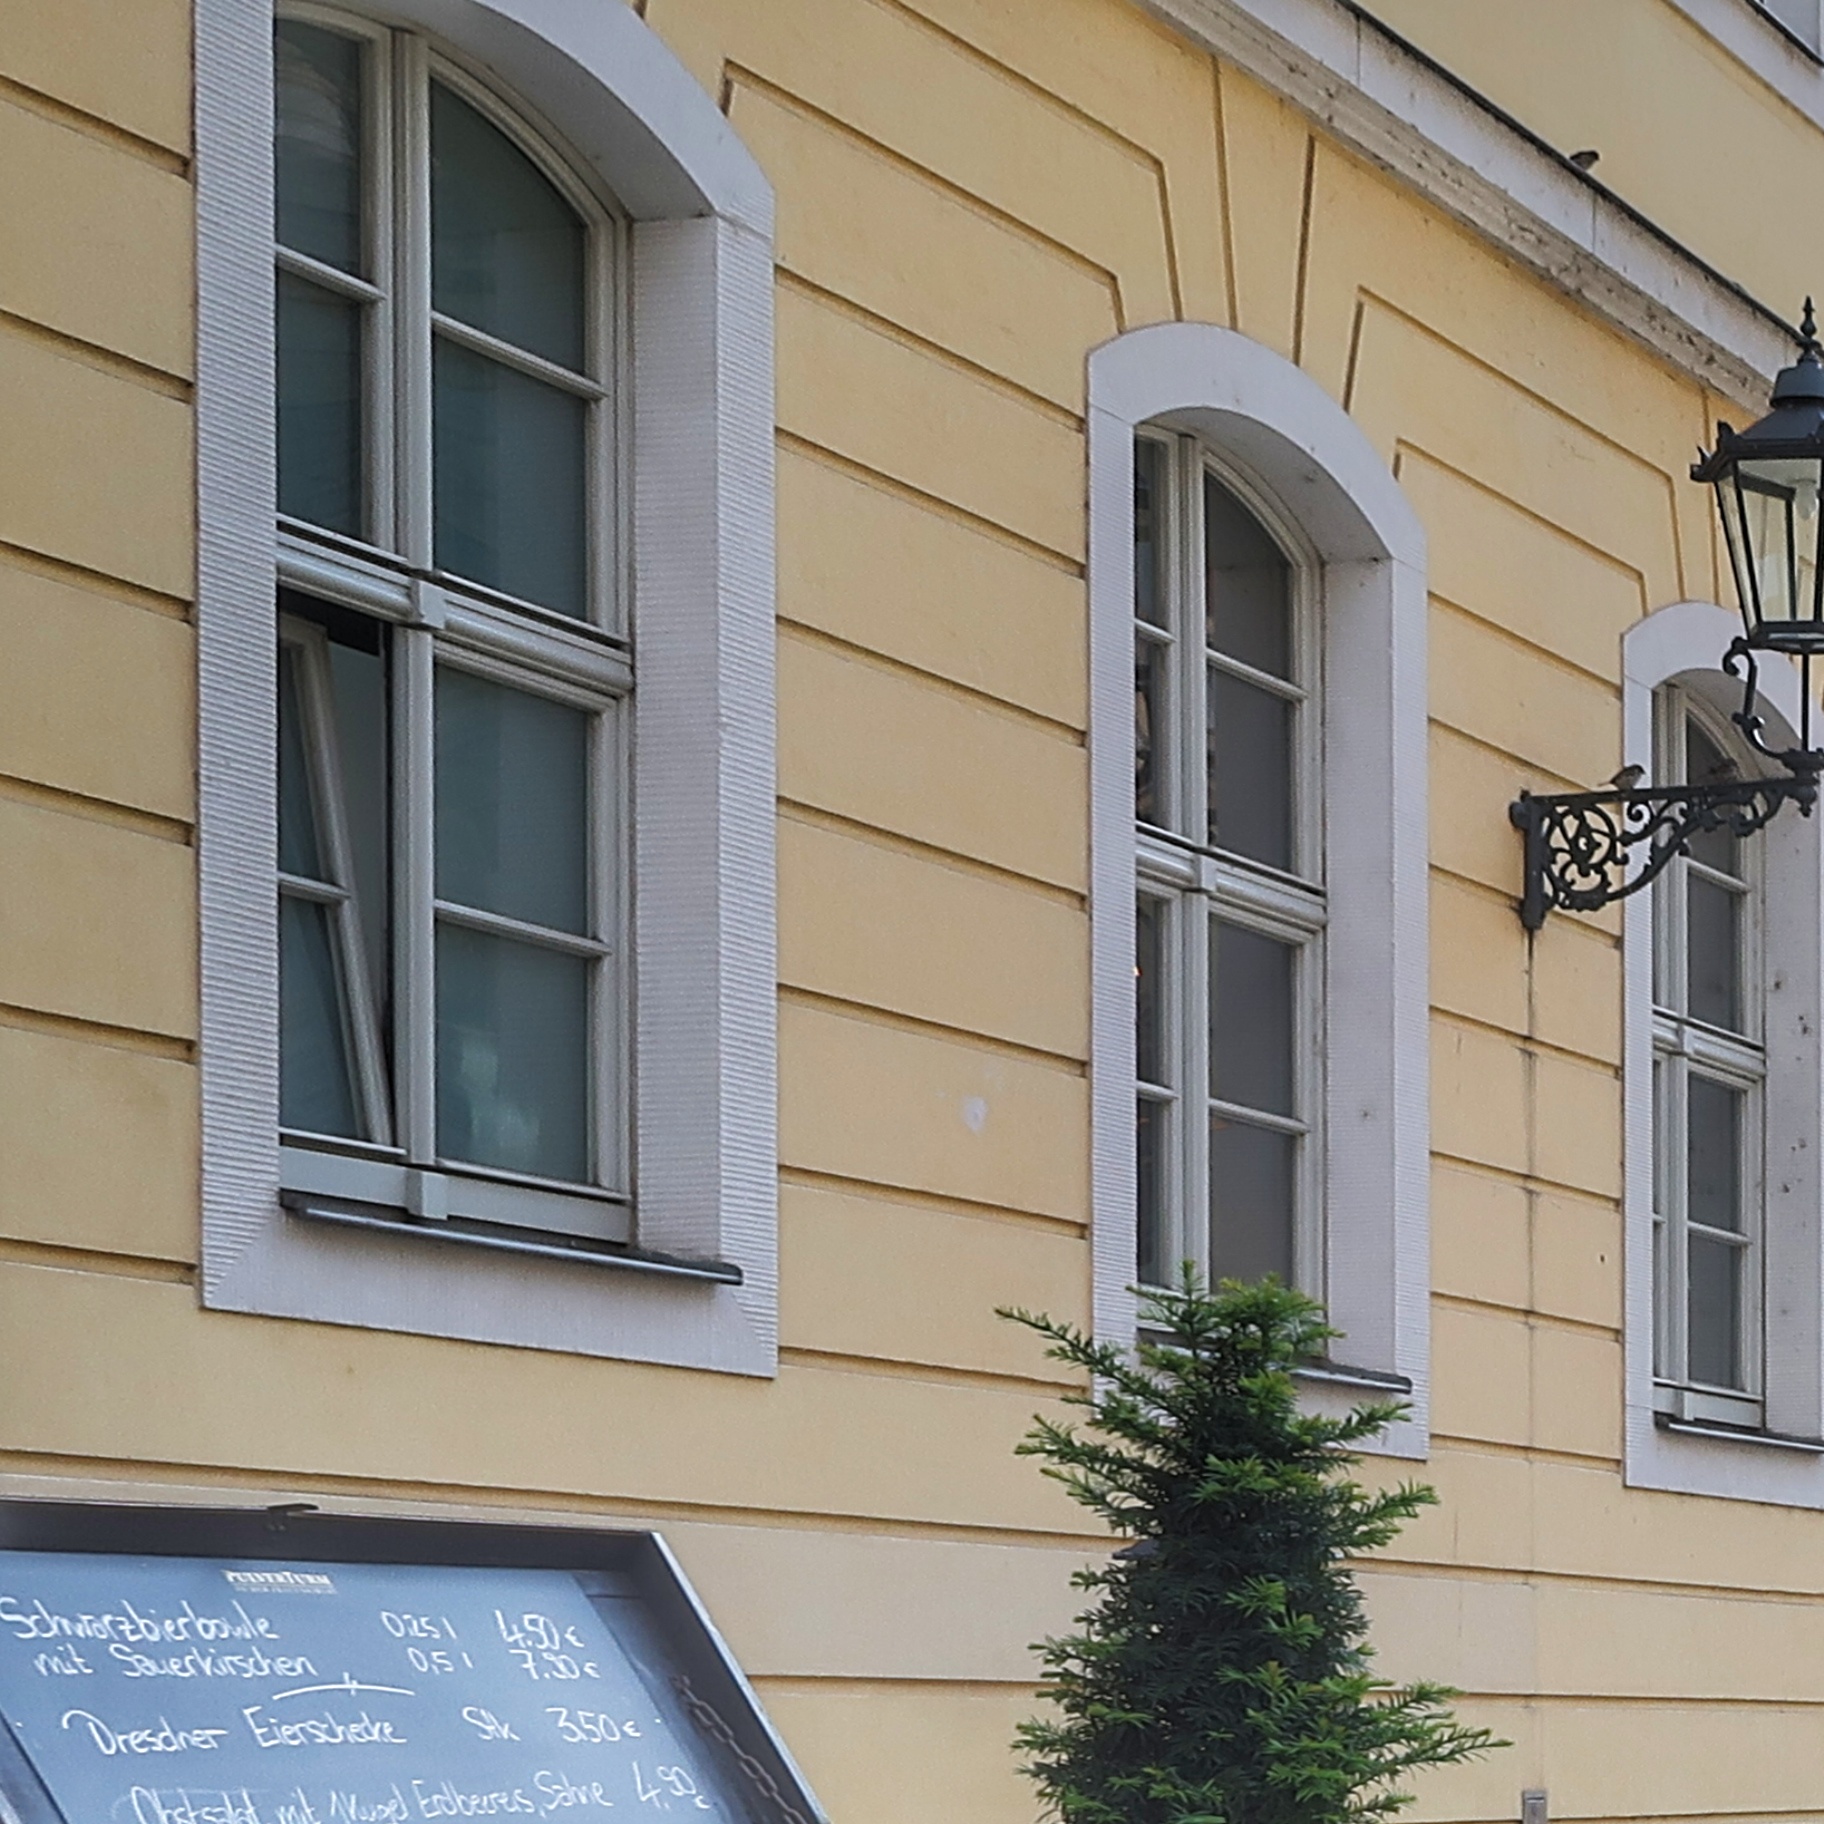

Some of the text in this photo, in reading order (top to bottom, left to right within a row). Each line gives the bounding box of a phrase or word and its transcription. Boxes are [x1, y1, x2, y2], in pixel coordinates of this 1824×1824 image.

[34, 1643, 93, 1676] mit
[109, 1644, 318, 1678] Sauerkirschen
[62, 1709, 228, 1755] Dresdner
[243, 1706, 407, 1748] Eierschecke
[533, 1770, 614, 1812] Sahne
